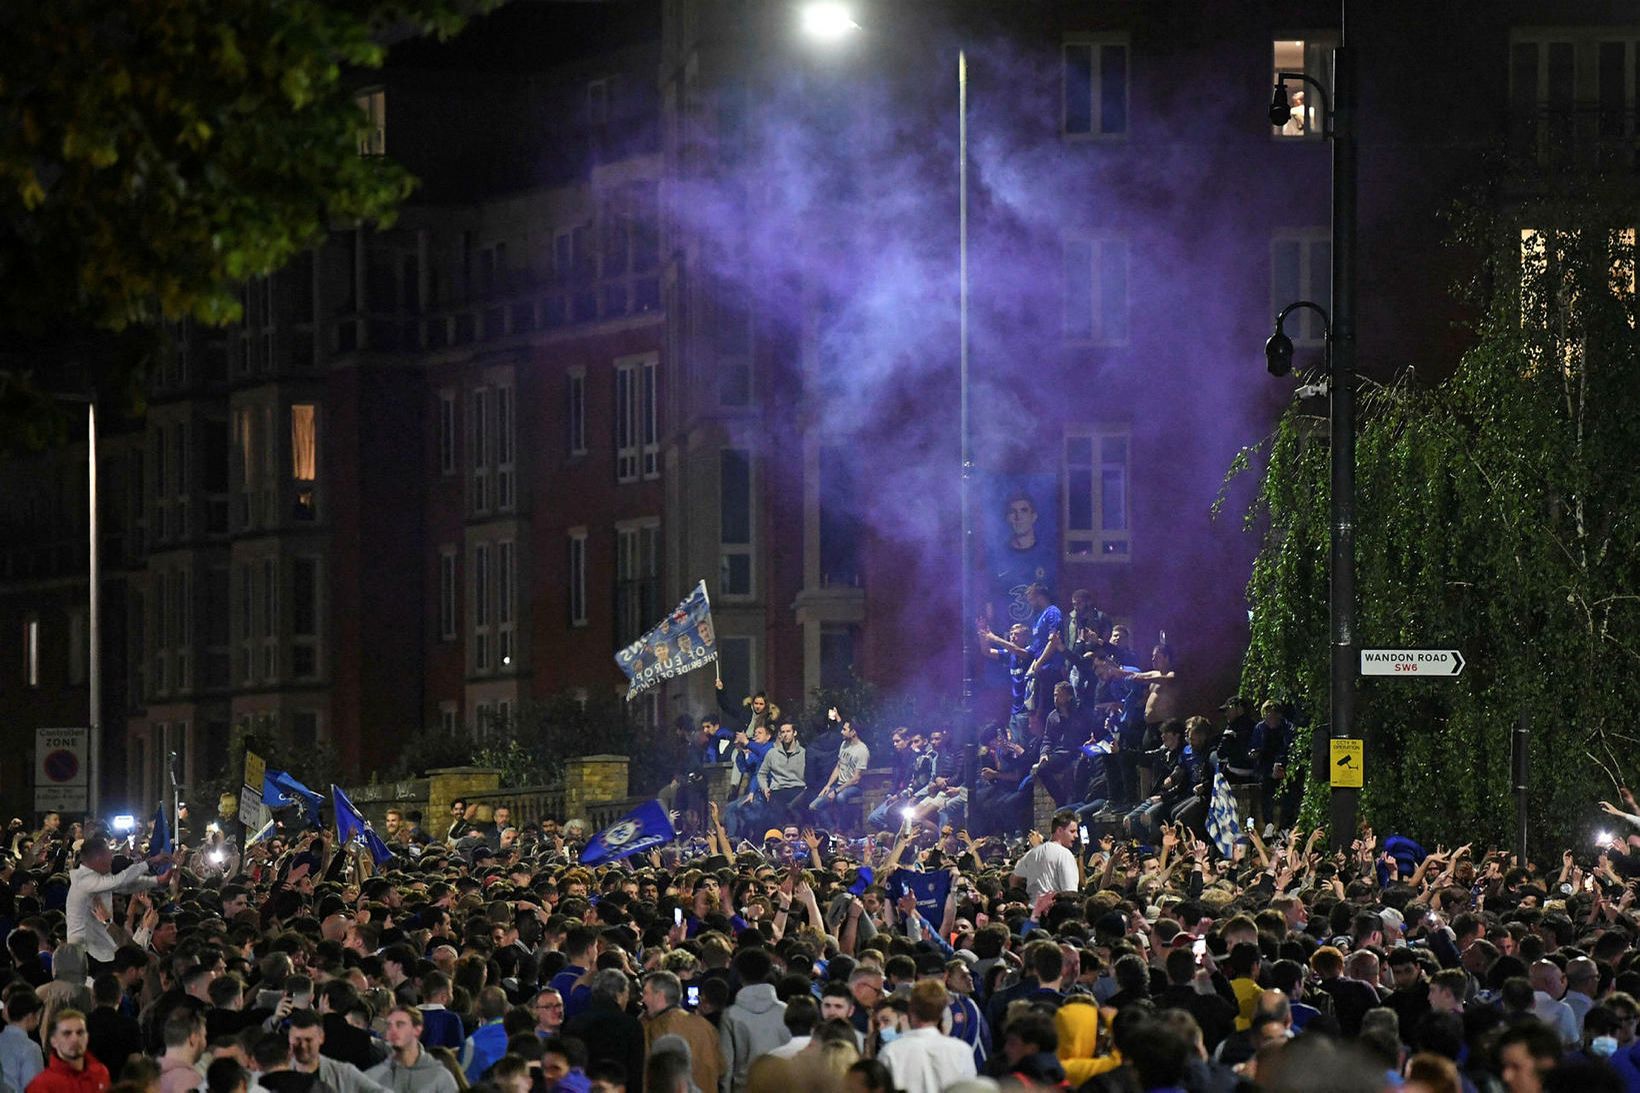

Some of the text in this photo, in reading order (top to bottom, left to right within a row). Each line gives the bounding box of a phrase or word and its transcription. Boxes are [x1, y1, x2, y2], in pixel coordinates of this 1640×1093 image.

[1365, 653, 1448, 662] WANDON ROAD
[1394, 663, 1418, 671] SW6
[46, 738, 80, 747] ZONE
